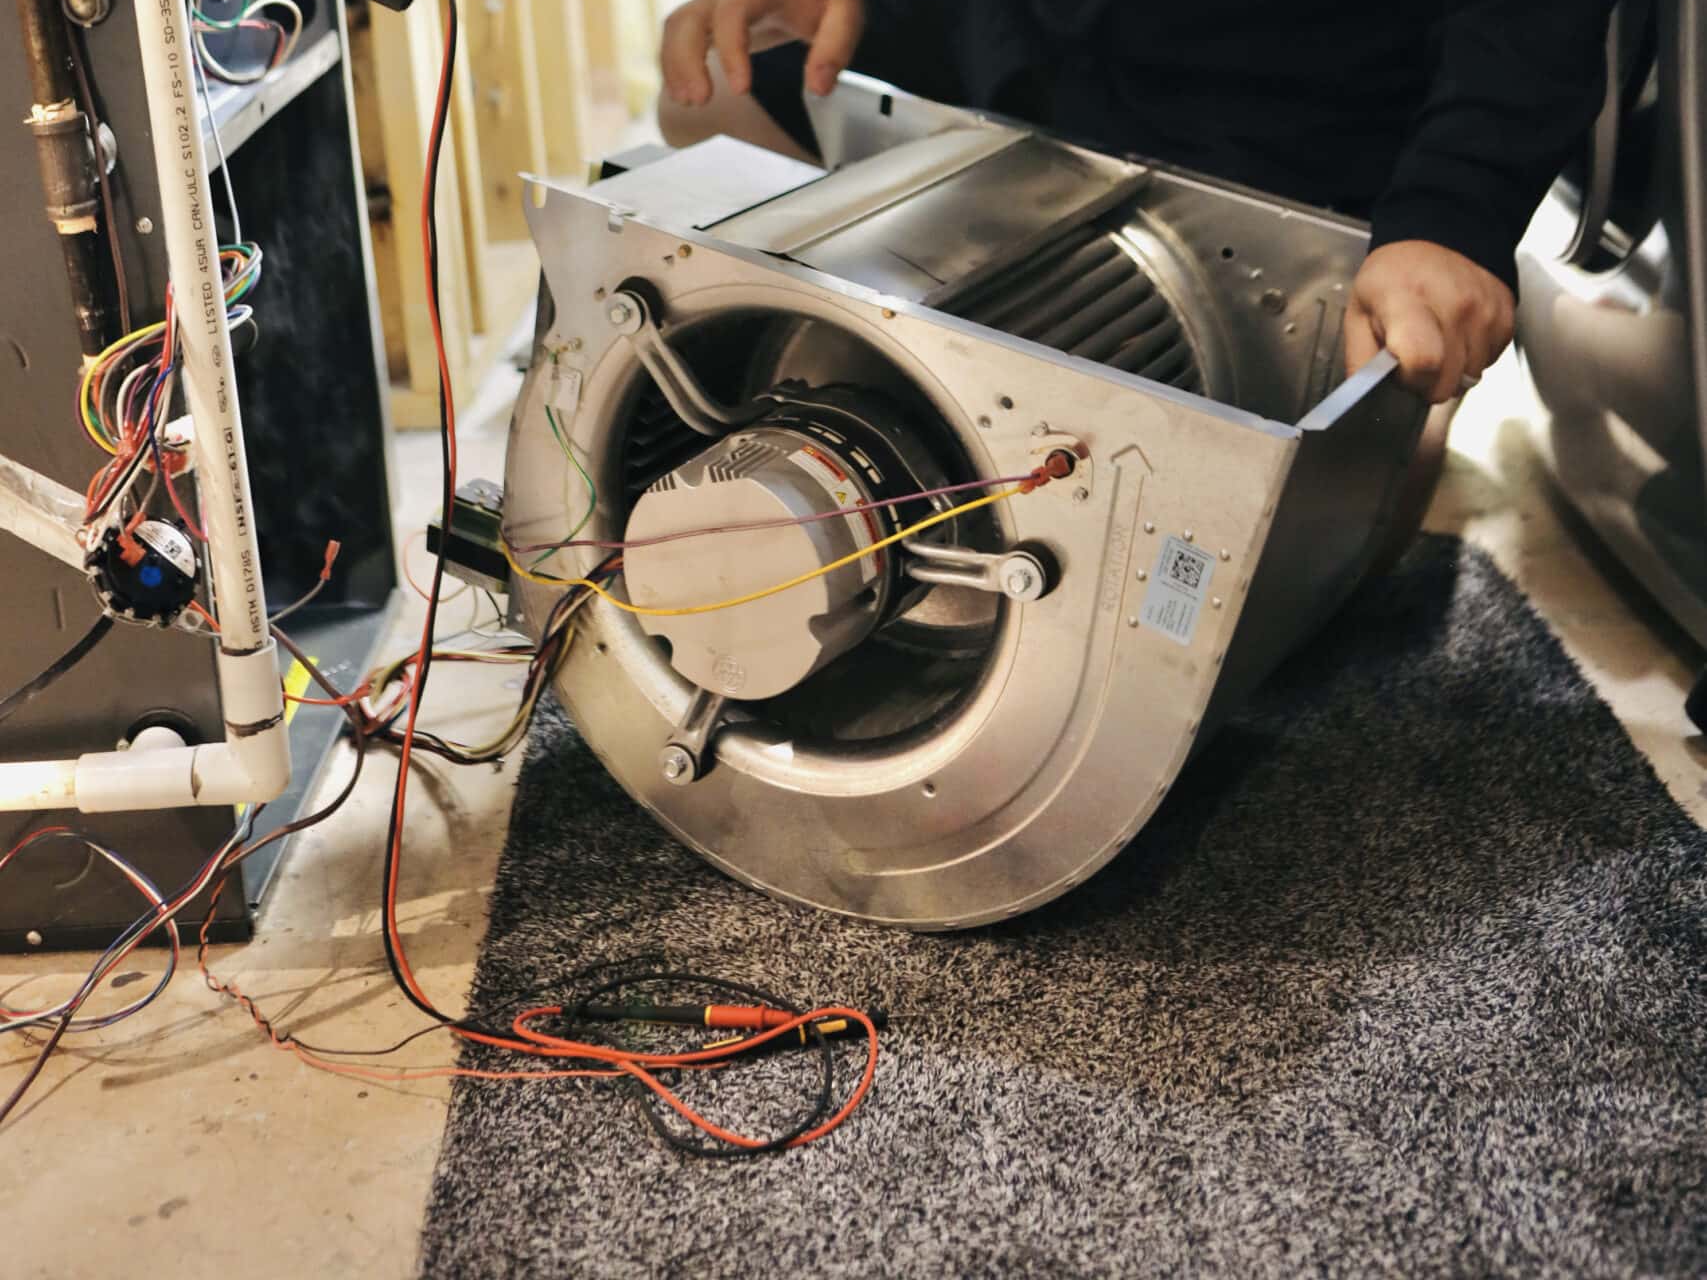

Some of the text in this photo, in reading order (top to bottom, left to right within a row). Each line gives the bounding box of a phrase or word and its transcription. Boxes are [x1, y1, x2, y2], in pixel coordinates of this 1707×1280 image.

[168, 52, 184, 98] FS-10
[176, 106, 192, 160] S102.2
[185, 168, 203, 230] CAN/ULC
[202, 282, 218, 335] LISTED
[241, 550, 256, 593] D1785
[248, 600, 262, 634] ASTM
